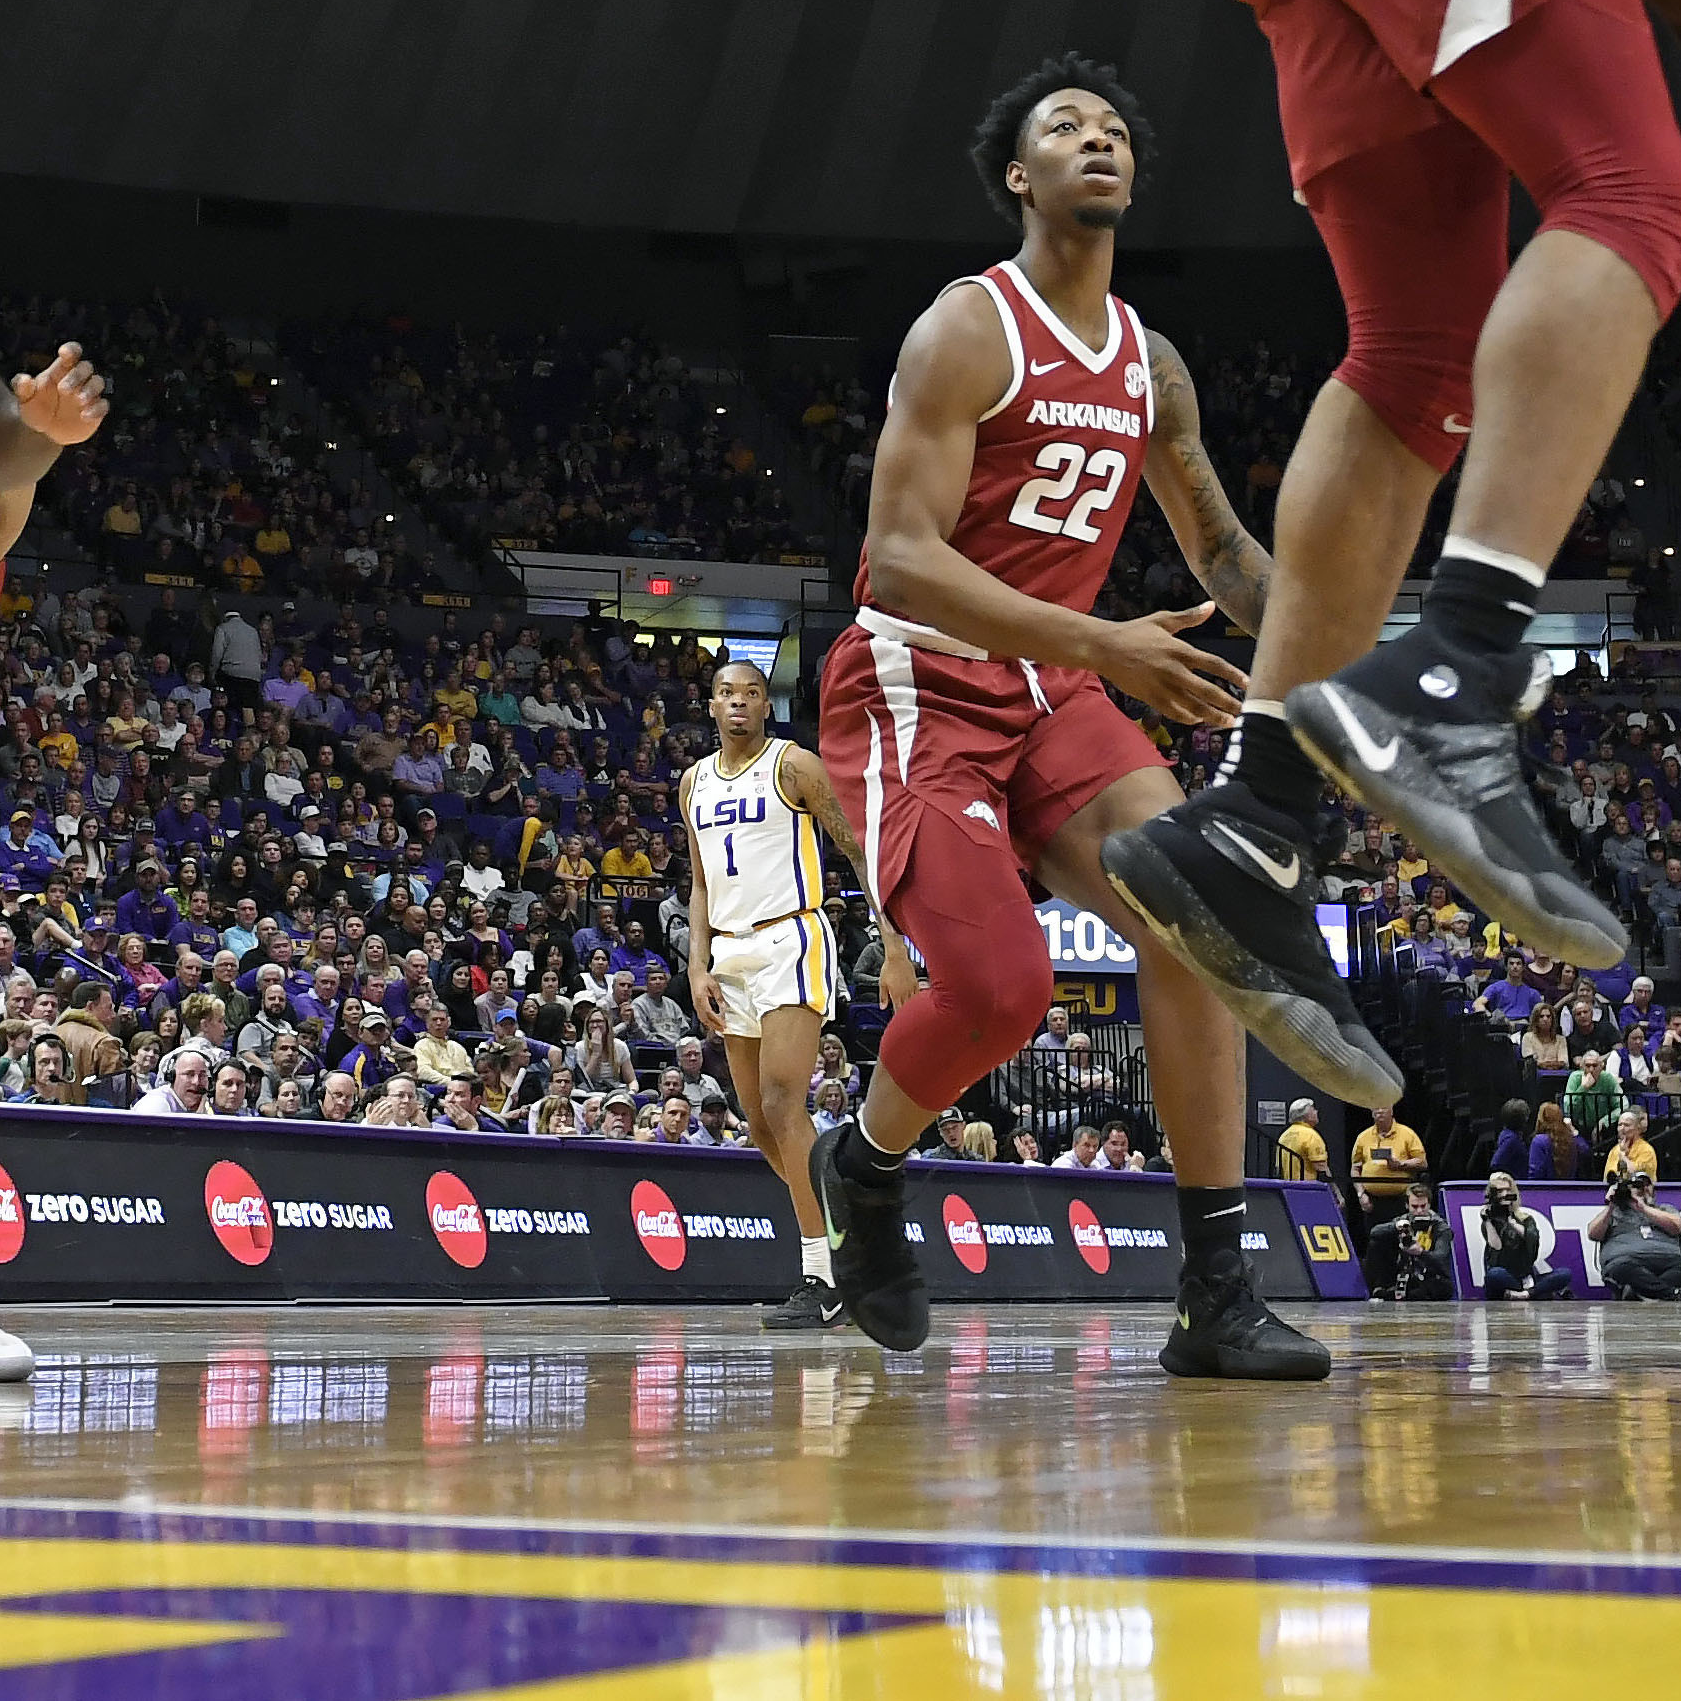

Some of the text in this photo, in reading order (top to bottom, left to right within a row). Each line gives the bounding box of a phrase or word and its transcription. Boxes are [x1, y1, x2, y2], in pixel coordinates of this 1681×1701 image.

[1026, 399, 1140, 439] ARKANSAS
[1008, 442, 1127, 544] 22
[696, 797, 766, 831] LSU
[724, 832, 739, 877] 1
[27, 1194, 87, 1223] zero
[93, 1196, 165, 1225] SUGAR
[273, 1201, 394, 1230] zero SUGAR
[486, 1208, 591, 1236] zero SUGAR
[684, 1214, 775, 1240] zero SUGAR
[1299, 1224, 1351, 1263] LSU
